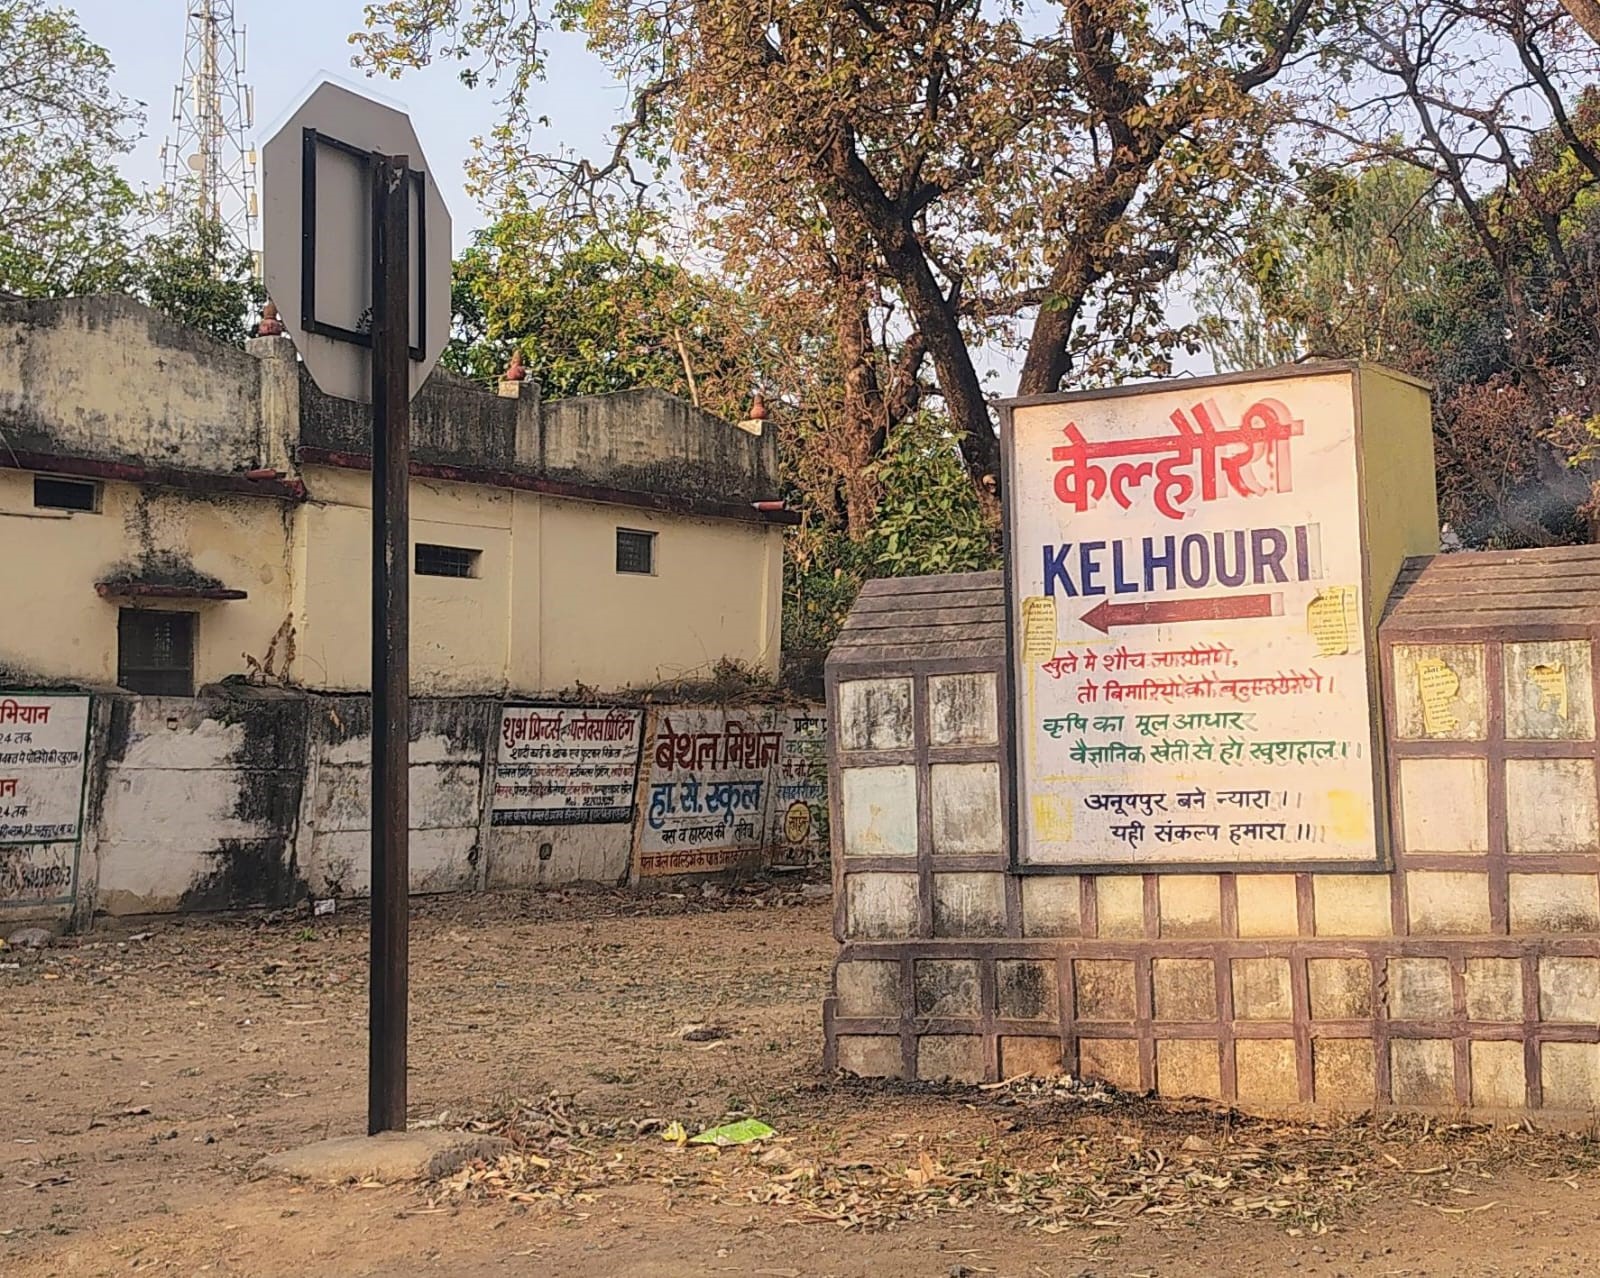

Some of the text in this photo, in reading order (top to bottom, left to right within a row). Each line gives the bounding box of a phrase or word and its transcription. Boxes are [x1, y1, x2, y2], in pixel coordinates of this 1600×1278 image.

[1043, 525, 1310, 598] KELHOURI
[1103, 646, 1146, 671] शौच
[1077, 678, 1099, 704] तो
[0, 699, 51, 724] भियान
[1043, 712, 1247, 738] कृषि का मूल आधार
[503, 717, 528, 748] शुभ
[656, 717, 721, 771] बेथल
[1070, 738, 1145, 768] वैज्ञानिक
[1150, 738, 1189, 763] खेती
[1192, 736, 1214, 761] से
[1220, 735, 1245, 765] हो
[706, 780, 763, 827] स्कूल
[1084, 790, 1168, 816] अनूपपुर
[1176, 787, 1206, 810] बने
[1217, 790, 1270, 809] न्यारा
[1110, 821, 1145, 848] यही
[1154, 820, 1220, 842] संकल्प
[1229, 823, 1286, 841] हमारा
